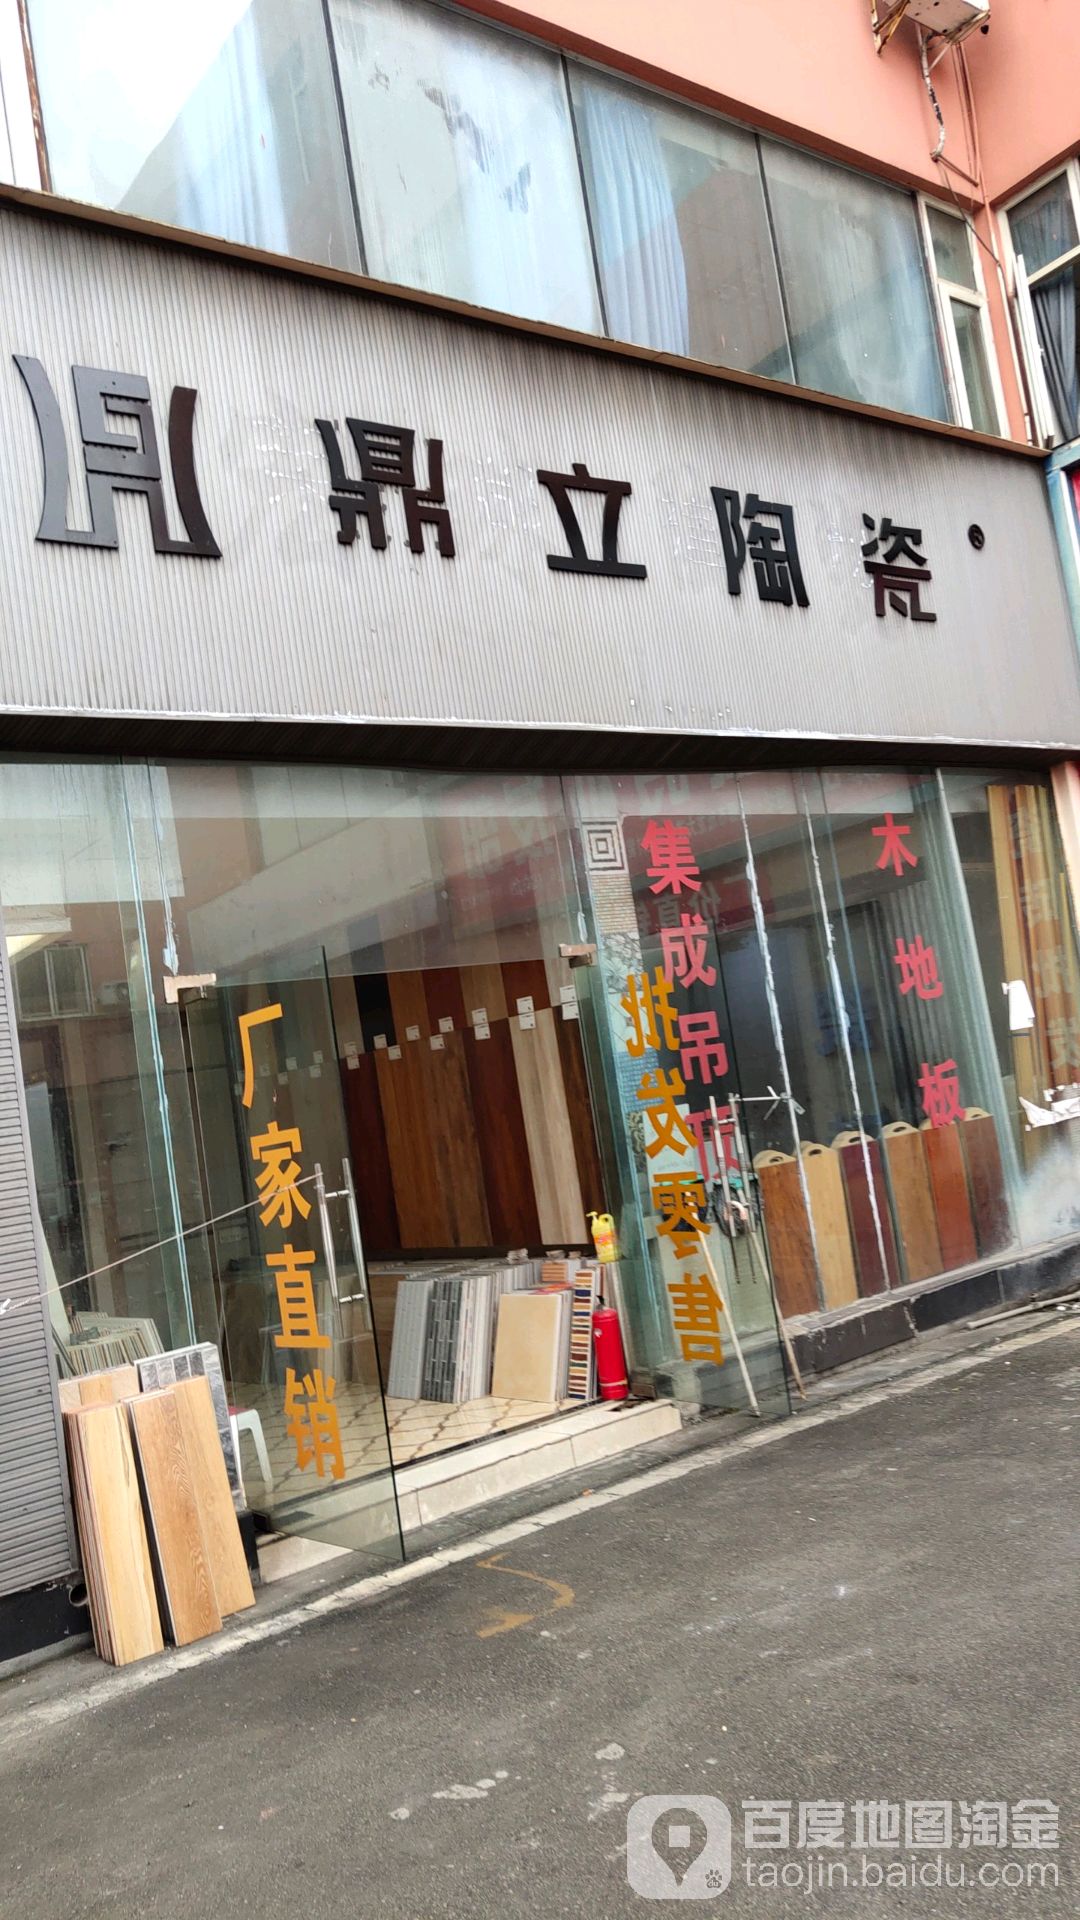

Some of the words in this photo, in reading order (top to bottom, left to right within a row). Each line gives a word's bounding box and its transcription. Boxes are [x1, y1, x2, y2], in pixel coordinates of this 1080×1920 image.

[314, 416, 937, 623] 鼎立陶瓷
[640, 818, 742, 1182] 集成吊顶
[871, 812, 968, 1129] 木地板
[237, 1002, 347, 1481] 厂家直销
